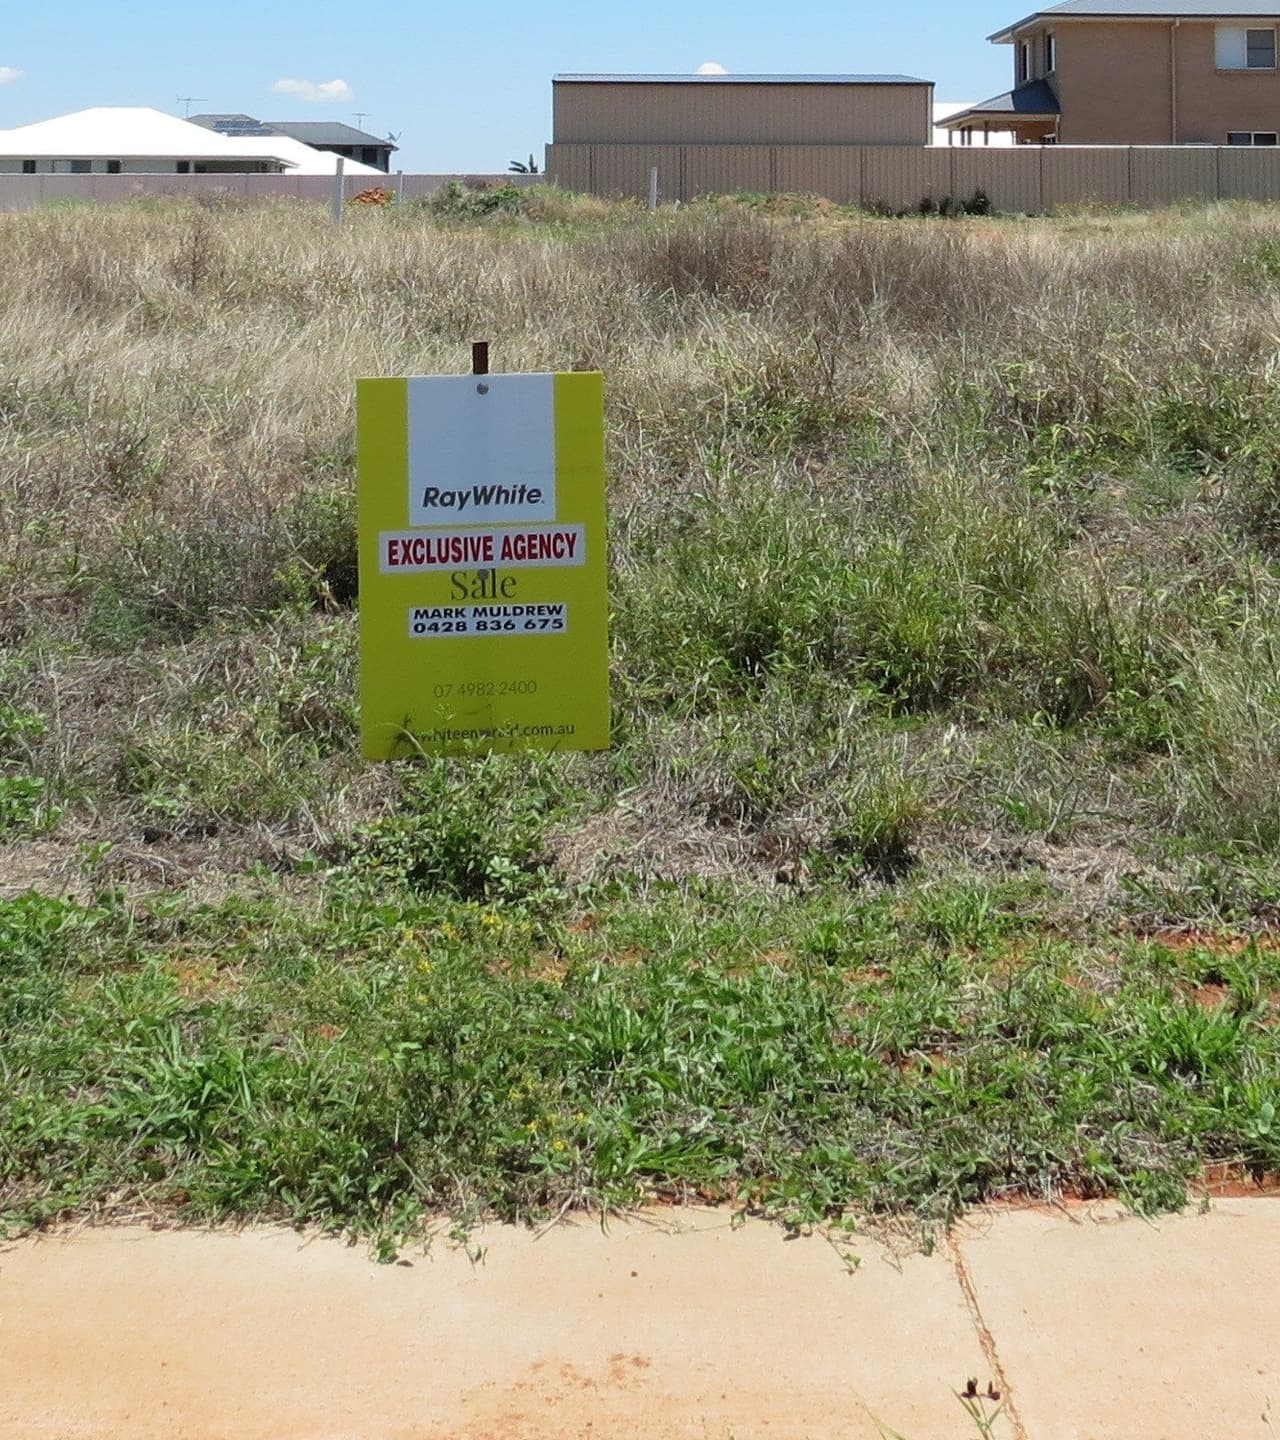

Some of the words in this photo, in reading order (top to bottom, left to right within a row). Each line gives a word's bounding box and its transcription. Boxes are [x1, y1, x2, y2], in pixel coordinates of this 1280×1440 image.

[388, 535, 494, 566] EXCLUSIVE
[501, 532, 577, 561] AGENCY
[451, 568, 517, 601] Sale
[414, 608, 466, 620] MARK
[473, 605, 563, 619] MULDREW
[413, 621, 467, 634] 0428
[475, 620, 516, 631] 836
[524, 618, 563, 630] 675
[433, 684, 453, 698] 07
[458, 681, 495, 697] 4982
[499, 679, 537, 695] 2400
